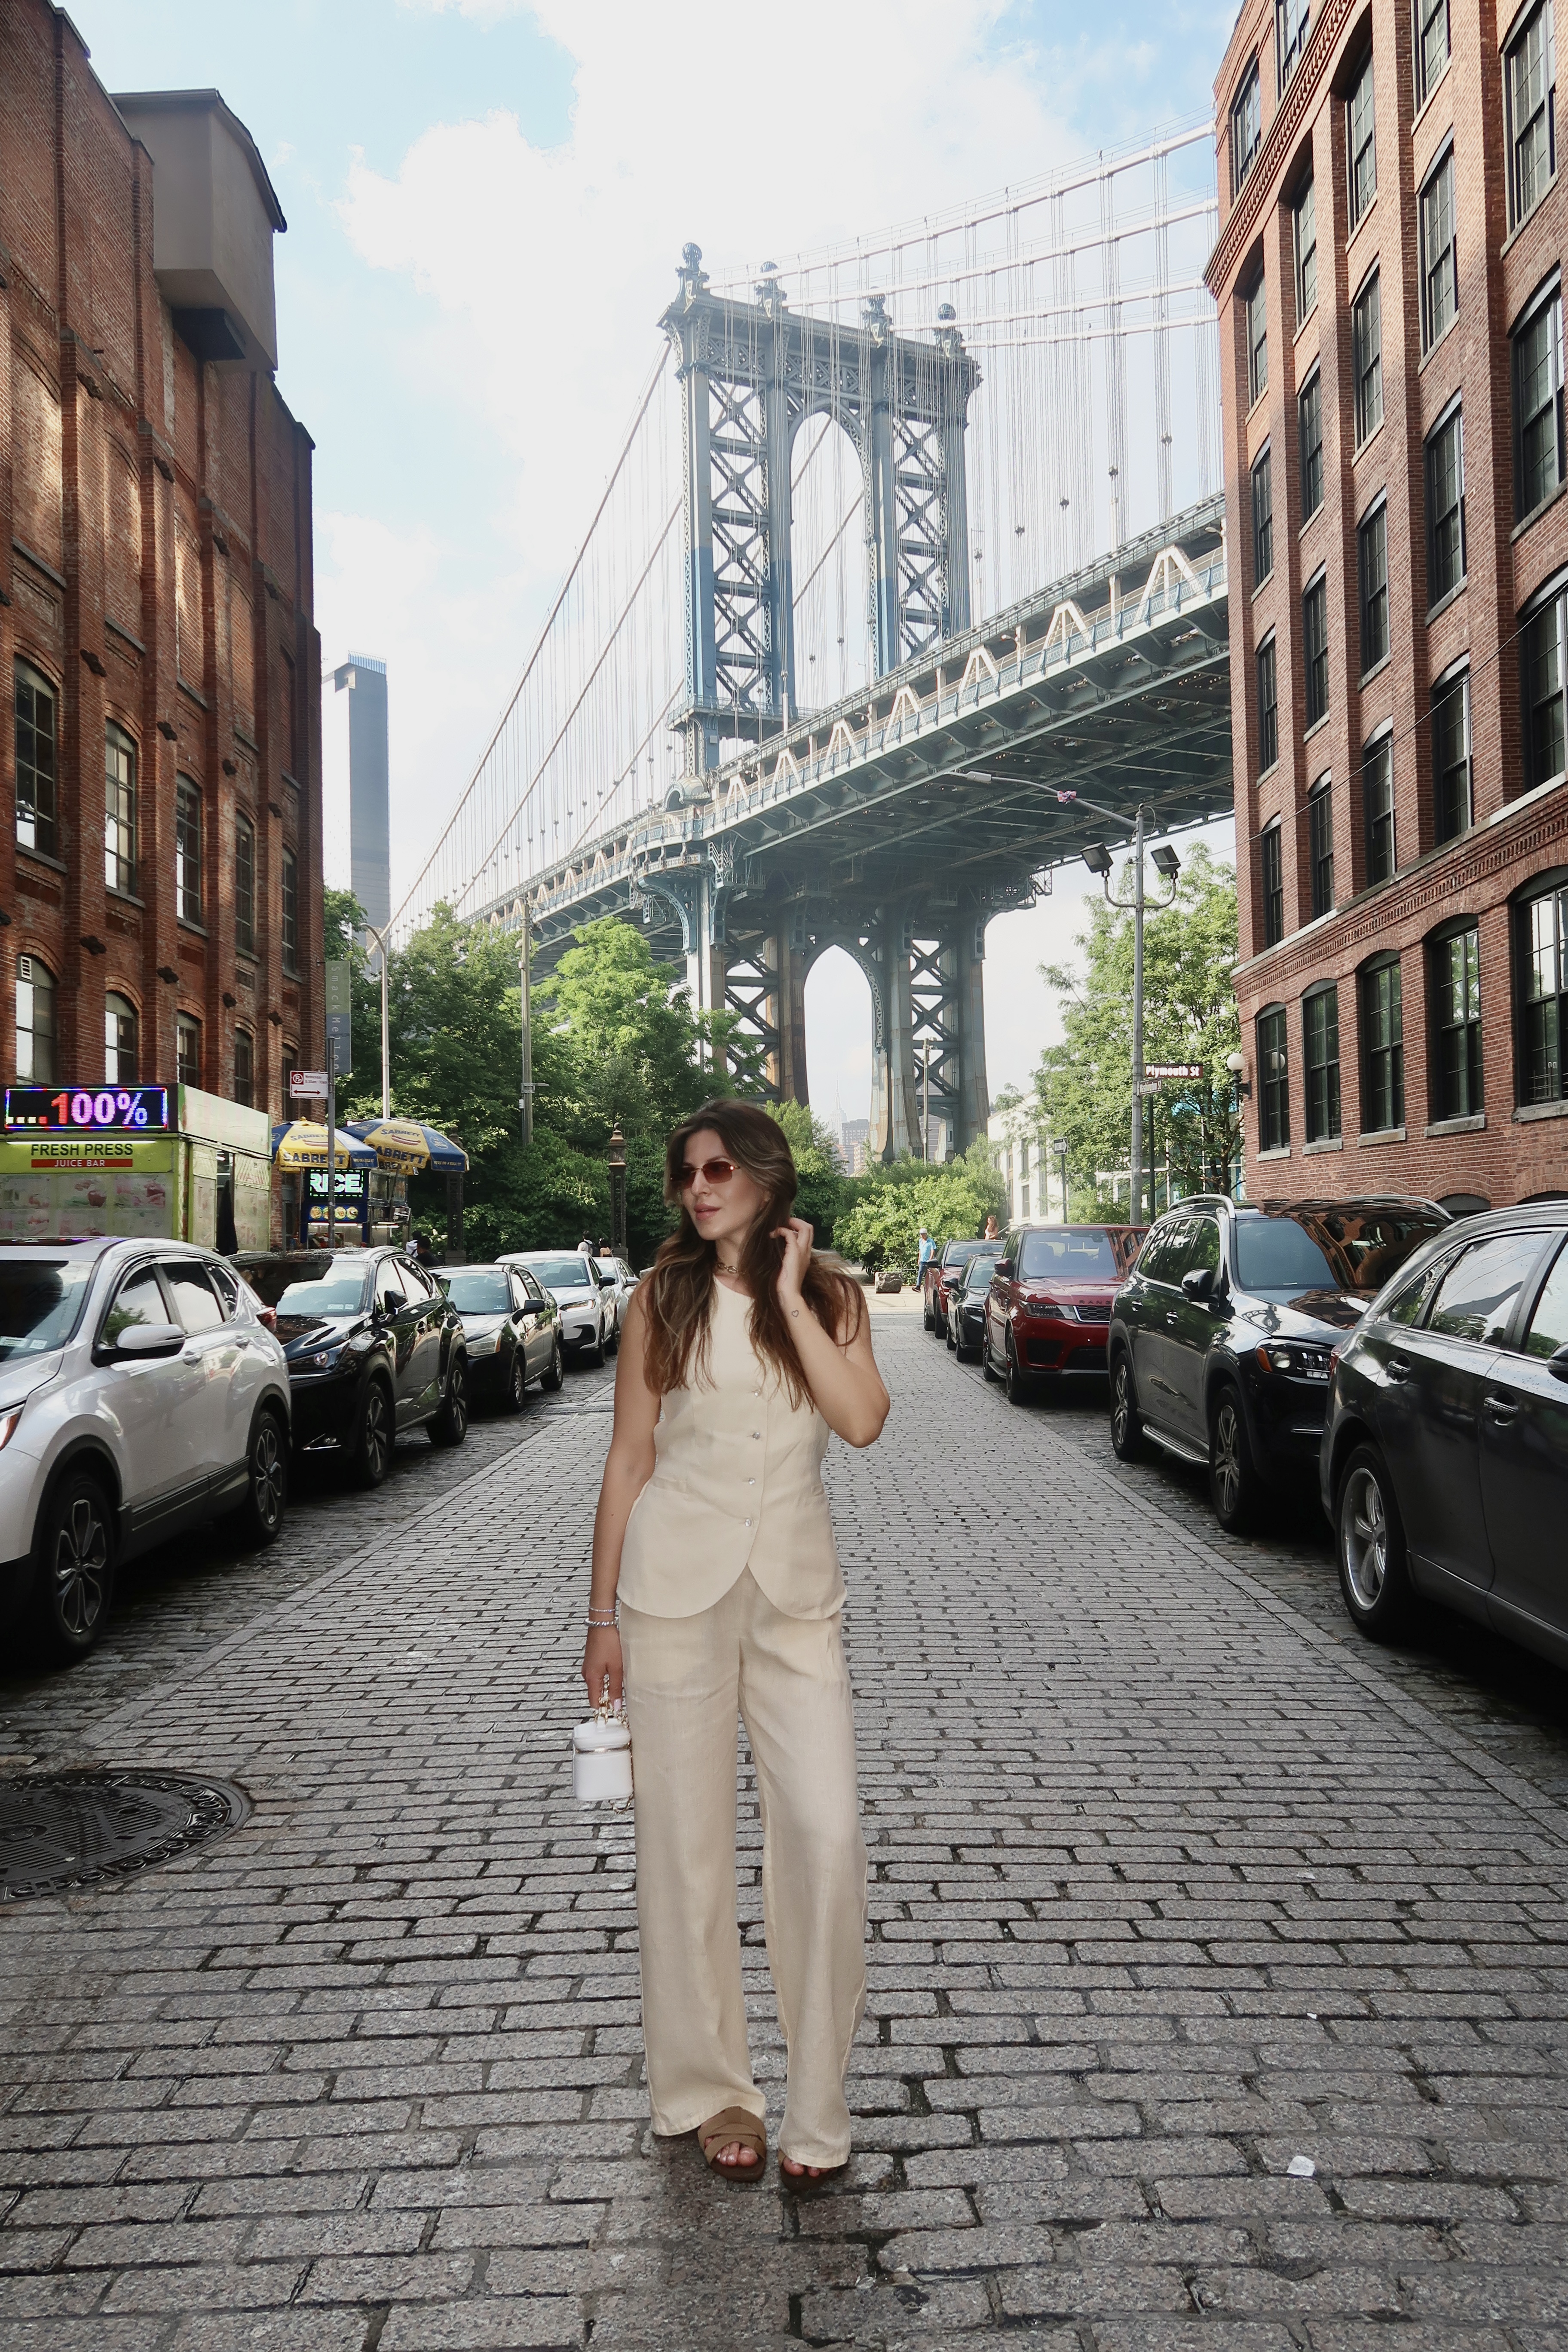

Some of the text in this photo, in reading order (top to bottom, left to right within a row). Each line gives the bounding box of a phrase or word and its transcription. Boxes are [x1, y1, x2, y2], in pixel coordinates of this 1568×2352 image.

[331, 967, 341, 1010] Smack
[1145, 1065, 1200, 1078] Plymouth St
[381, 1129, 420, 1137] SABRETT
[31, 1143, 133, 1156] FRESH PRESS
[54, 1159, 105, 1167] JUICE BAR
[284, 1152, 346, 1164] SABRET
